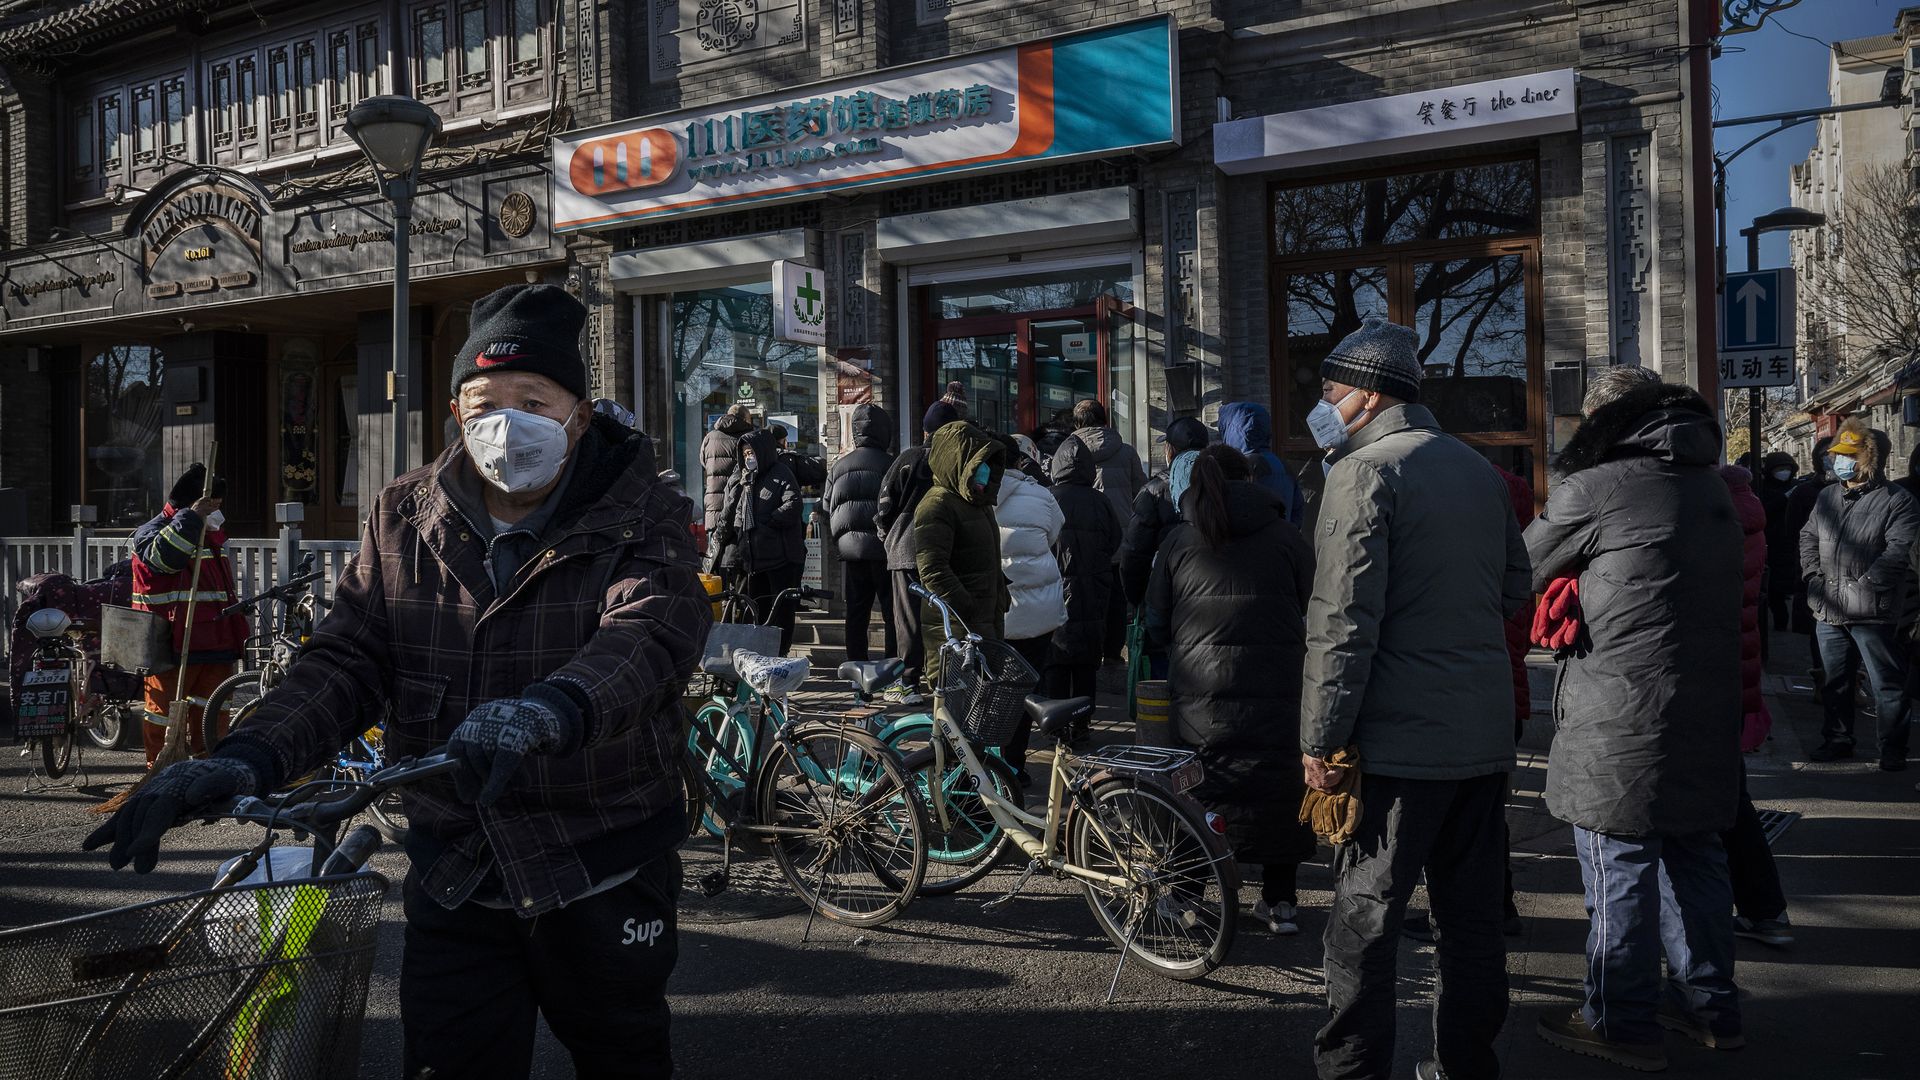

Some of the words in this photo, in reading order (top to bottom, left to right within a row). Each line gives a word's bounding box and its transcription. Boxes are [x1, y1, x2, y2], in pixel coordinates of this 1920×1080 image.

[1491, 90, 1515, 111] the
[1521, 88, 1560, 104] diner
[171, 192, 257, 238] NOSTALGIA
[485, 342, 520, 355] NIKE
[1720, 355, 1789, 380] 机动车
[20, 689, 67, 705] 安定门
[621, 918, 664, 947] Sup
